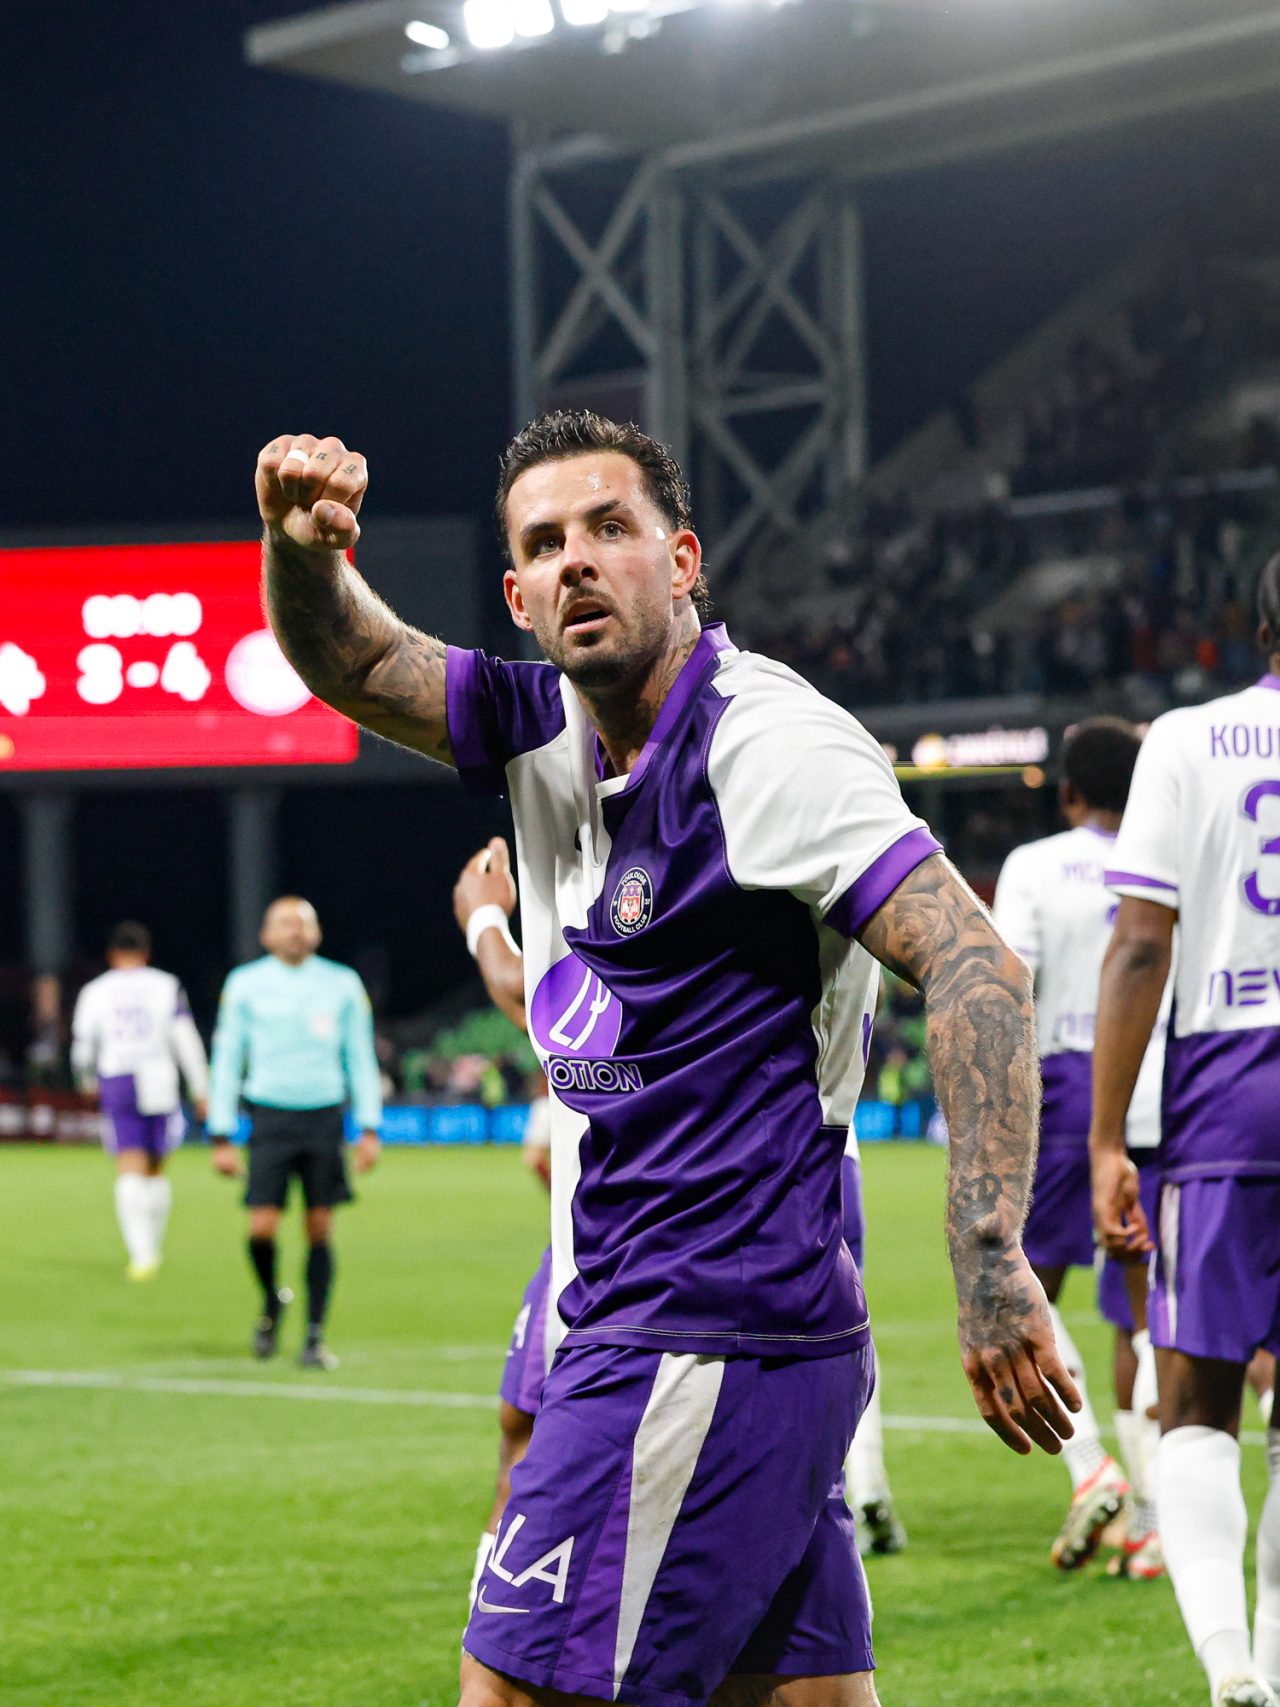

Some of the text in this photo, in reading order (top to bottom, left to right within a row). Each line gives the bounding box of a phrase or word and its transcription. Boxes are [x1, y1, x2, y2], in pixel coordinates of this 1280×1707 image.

[1211, 725, 1280, 758] KOU
[614, 914, 647, 933] FOOTBALL CLUB
[1209, 969, 1280, 1006] NE
[542, 1058, 644, 1092] OTION
[488, 1513, 574, 1603] LA
